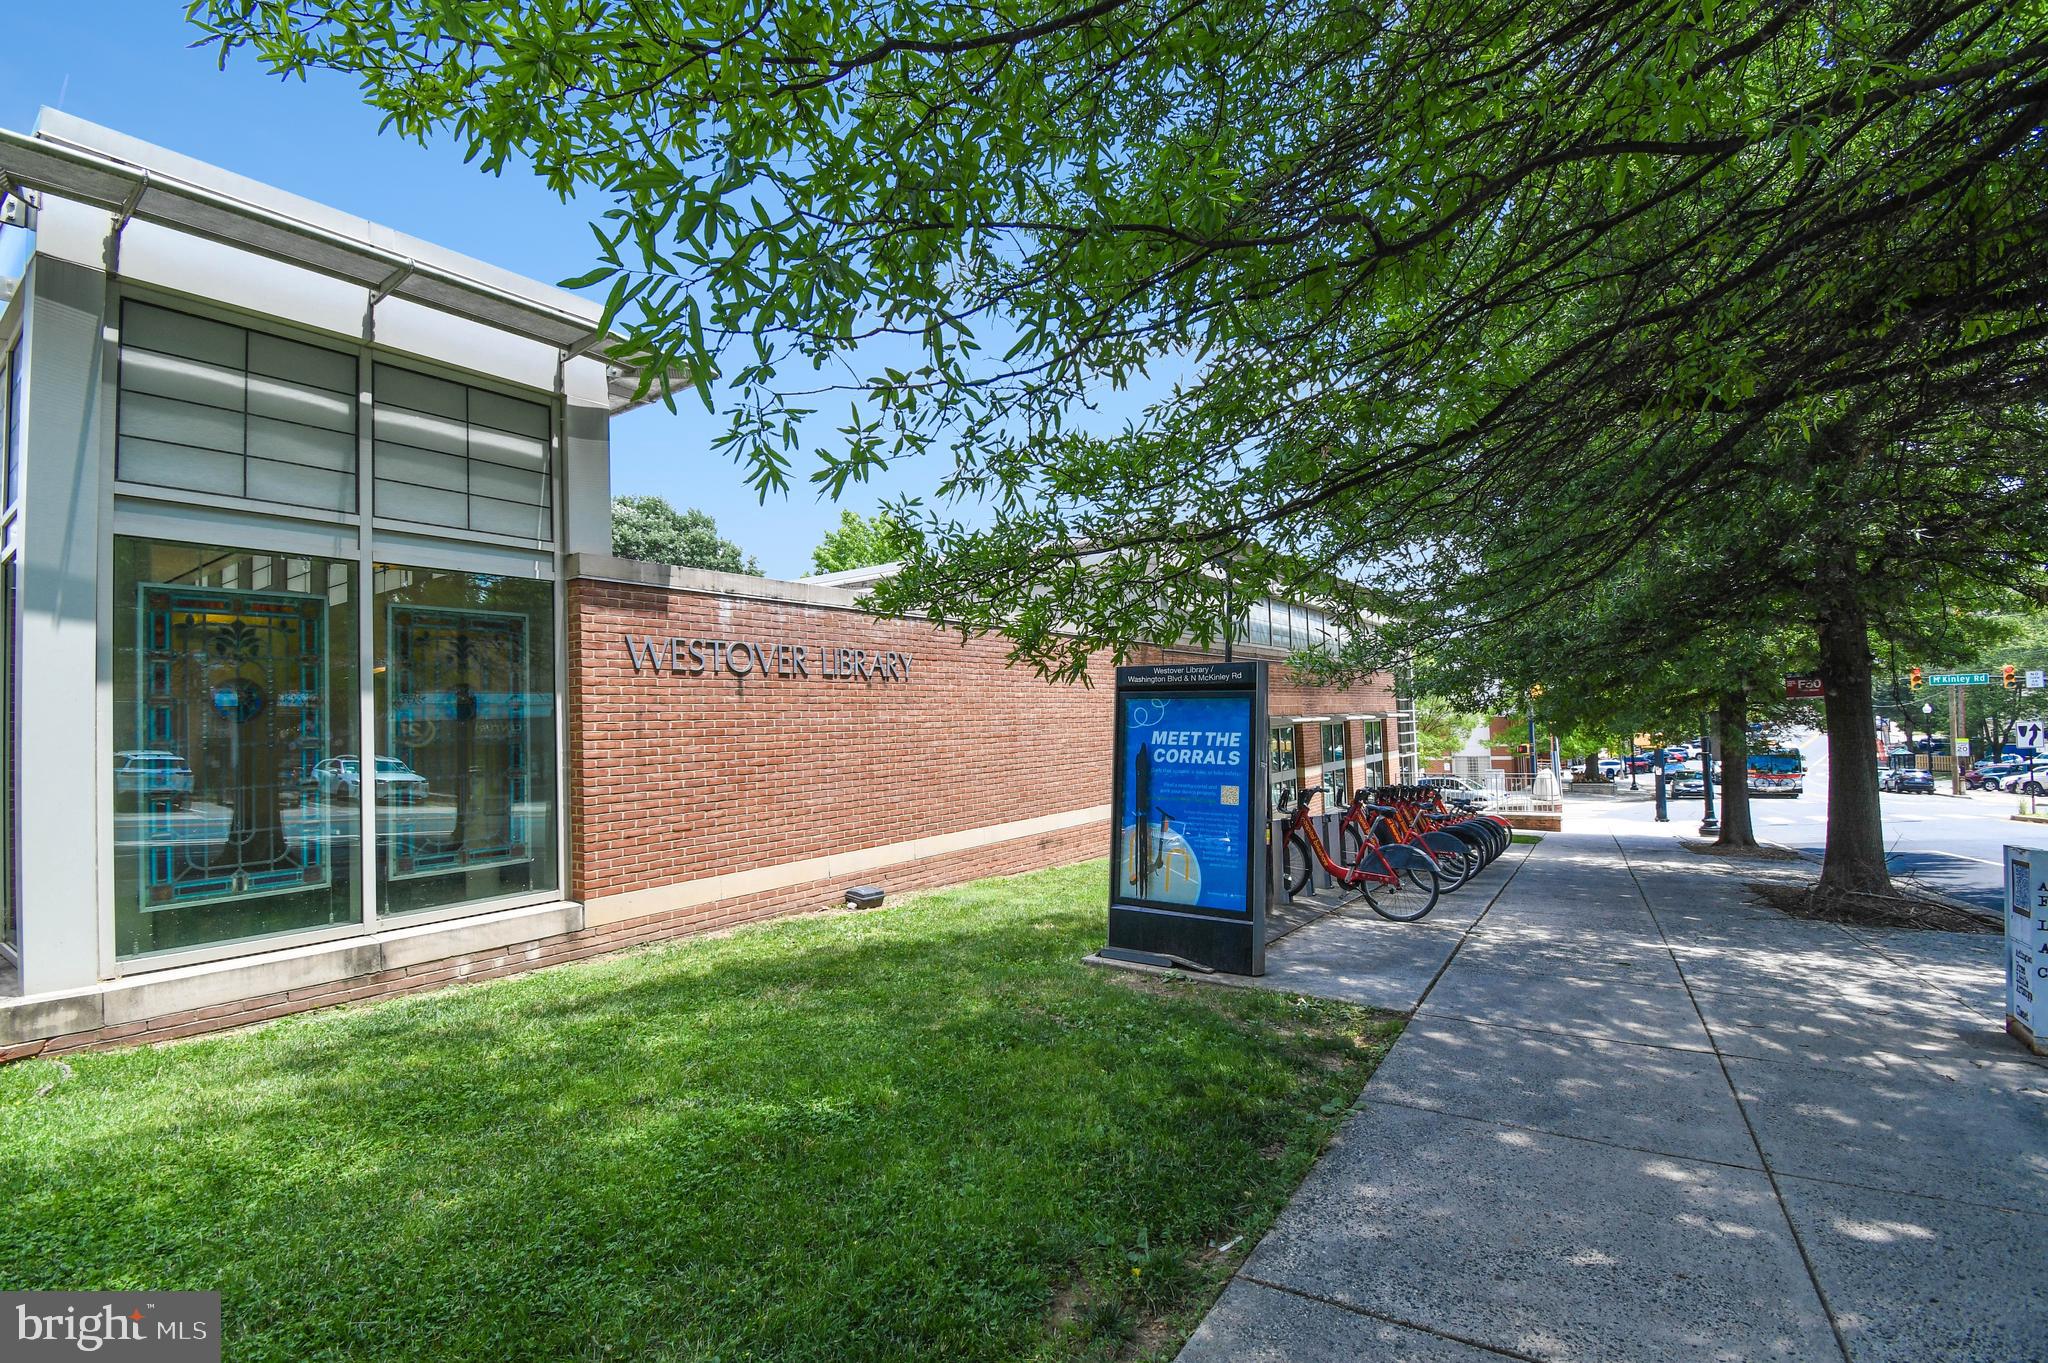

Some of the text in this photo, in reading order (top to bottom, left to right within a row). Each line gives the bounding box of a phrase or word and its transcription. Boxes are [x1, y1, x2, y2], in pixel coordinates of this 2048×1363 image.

[625, 634, 913, 682] WESTOVER LIBRARY
[1127, 675, 1166, 684] Washington
[1167, 674, 1183, 682] Blvd
[1184, 674, 1191, 682] &
[1191, 673, 1197, 681] N
[1198, 672, 1230, 682] McKinley
[1153, 667, 1185, 675] Westover
[1186, 666, 1210, 674] Library
[1151, 730, 1241, 747] MEET THE
[1153, 748, 1241, 766] CORRALS
